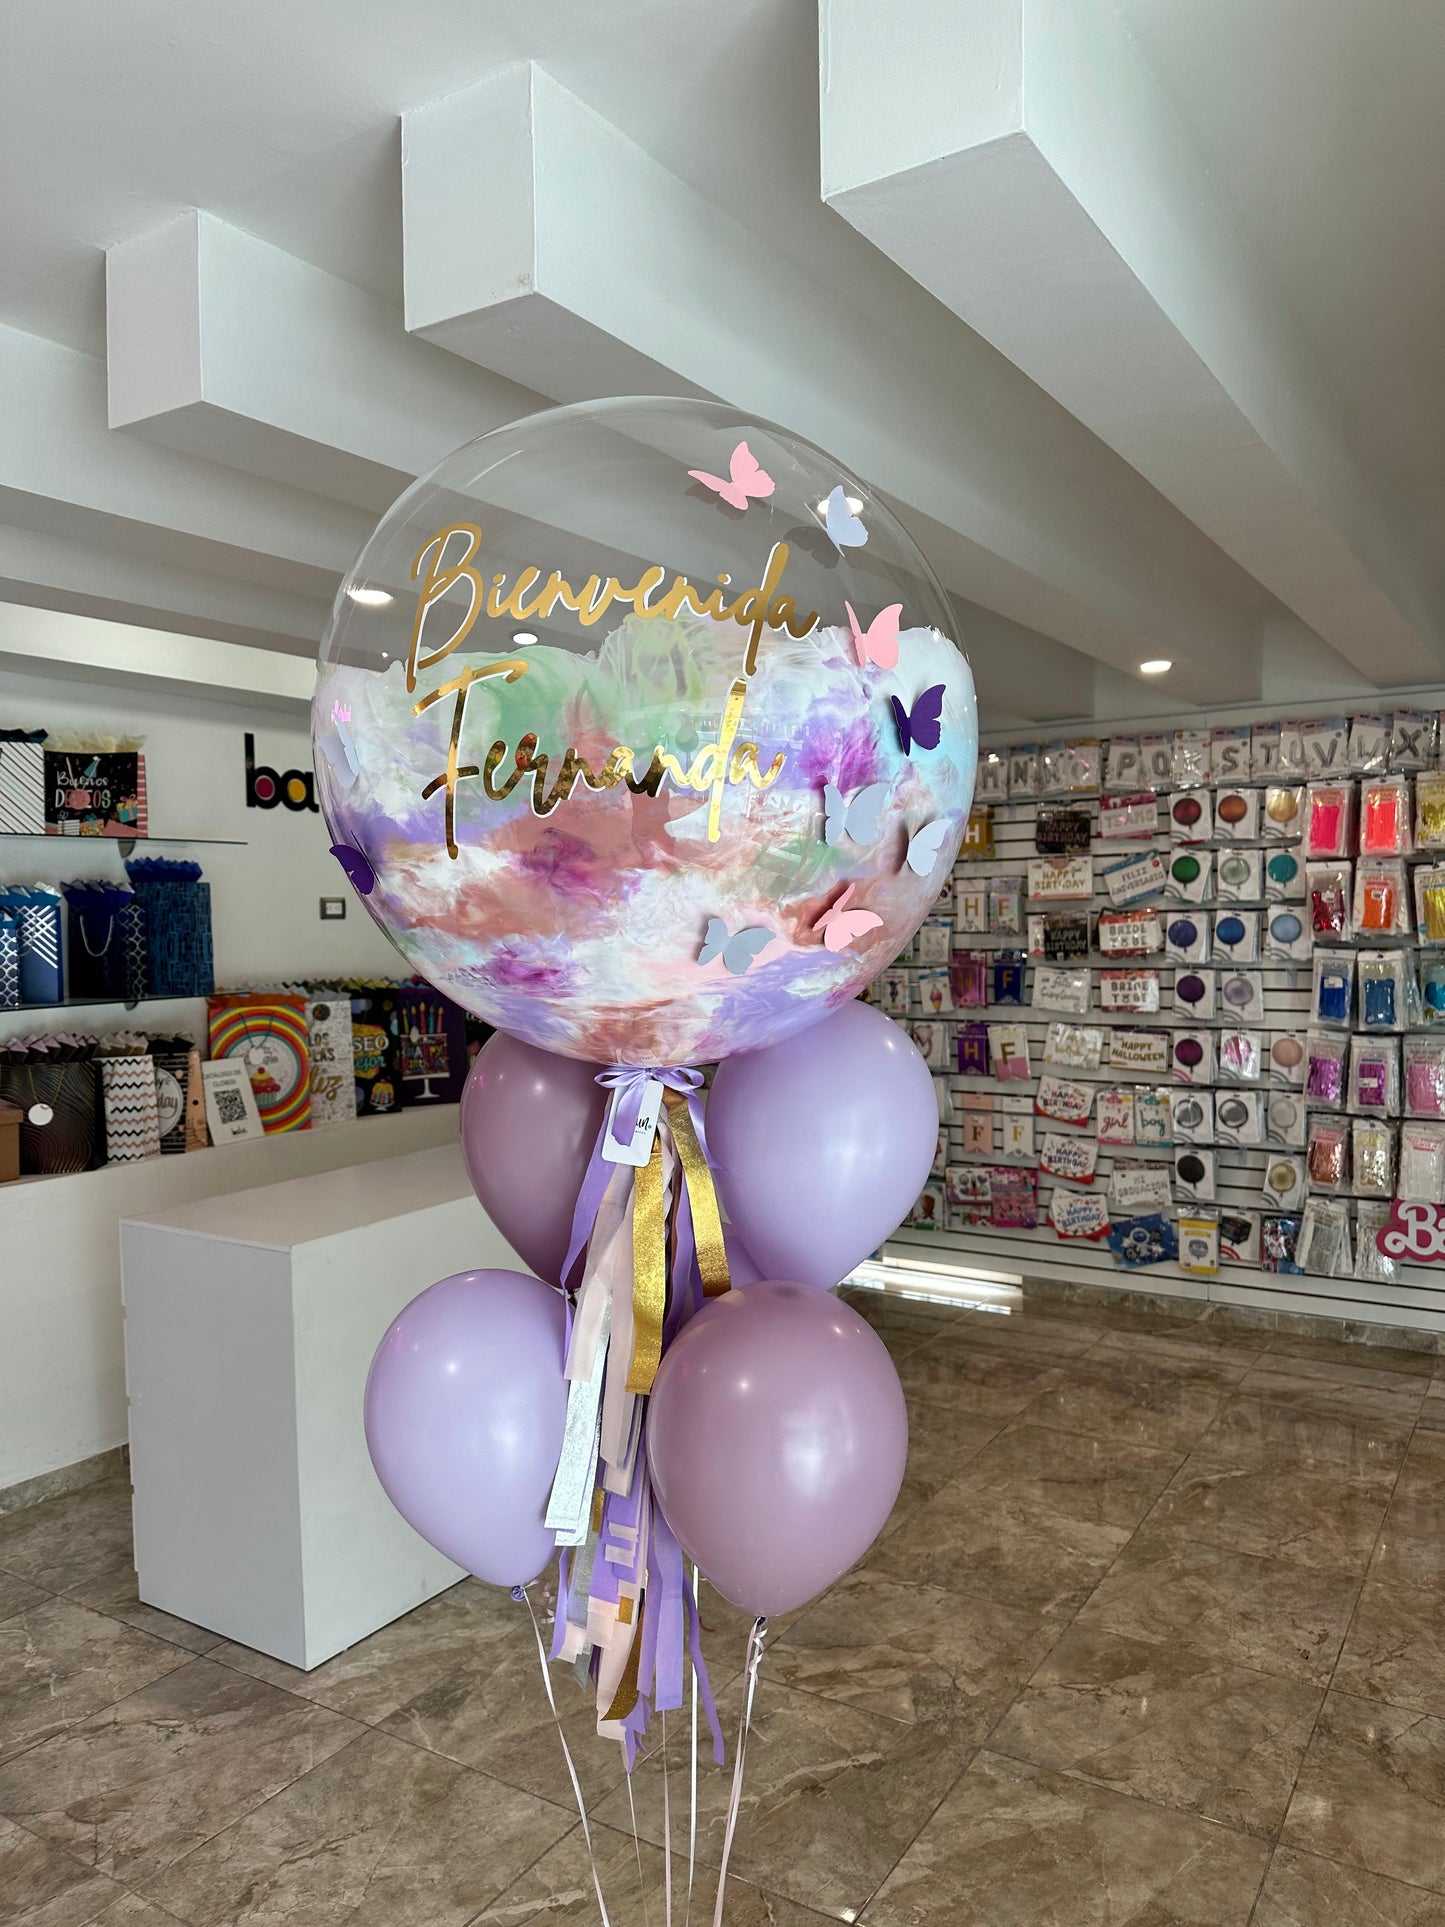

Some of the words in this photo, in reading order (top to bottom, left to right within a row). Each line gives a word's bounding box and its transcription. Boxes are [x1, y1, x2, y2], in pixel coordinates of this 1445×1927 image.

[410, 522, 820, 693] Bienvenida
[1312, 738, 1338, 768] V
[1394, 727, 1422, 760] X
[411, 660, 787, 859] Fernanda
[1221, 745, 1240, 774] S
[1260, 740, 1280, 768] T
[1116, 751, 1137, 780] P
[56, 770, 109, 787] Buenos
[55, 788, 111, 809] DOS
[964, 824, 980, 844] H
[1042, 870, 1077, 880] HAPPY
[1121, 867, 1148, 881] FELIZ
[1034, 879, 1086, 890] BIRTHDAY
[964, 897, 979, 917] H
[997, 898, 1010, 917] F
[1050, 928, 1080, 941] HAPPY
[1109, 923, 1149, 936] BRIDE
[959, 970, 974, 993] H
[1002, 970, 1014, 989] F
[963, 1041, 979, 1061] H
[1001, 1042, 1016, 1066] F
[1111, 1047, 1165, 1062] HALLOWEEN
[1120, 1040, 1153, 1052] HAPPY
[1100, 1111, 1129, 1134] girl
[1140, 1109, 1166, 1137] boy
[972, 1125, 985, 1142] F
[1012, 1125, 1025, 1142] F
[1047, 1155, 1088, 1169] BIRTHDAY
[1055, 1147, 1083, 1160] HAPPY
[1061, 1213, 1101, 1228] BIRTHDAY
[1066, 1206, 1092, 1217] HAPPY
